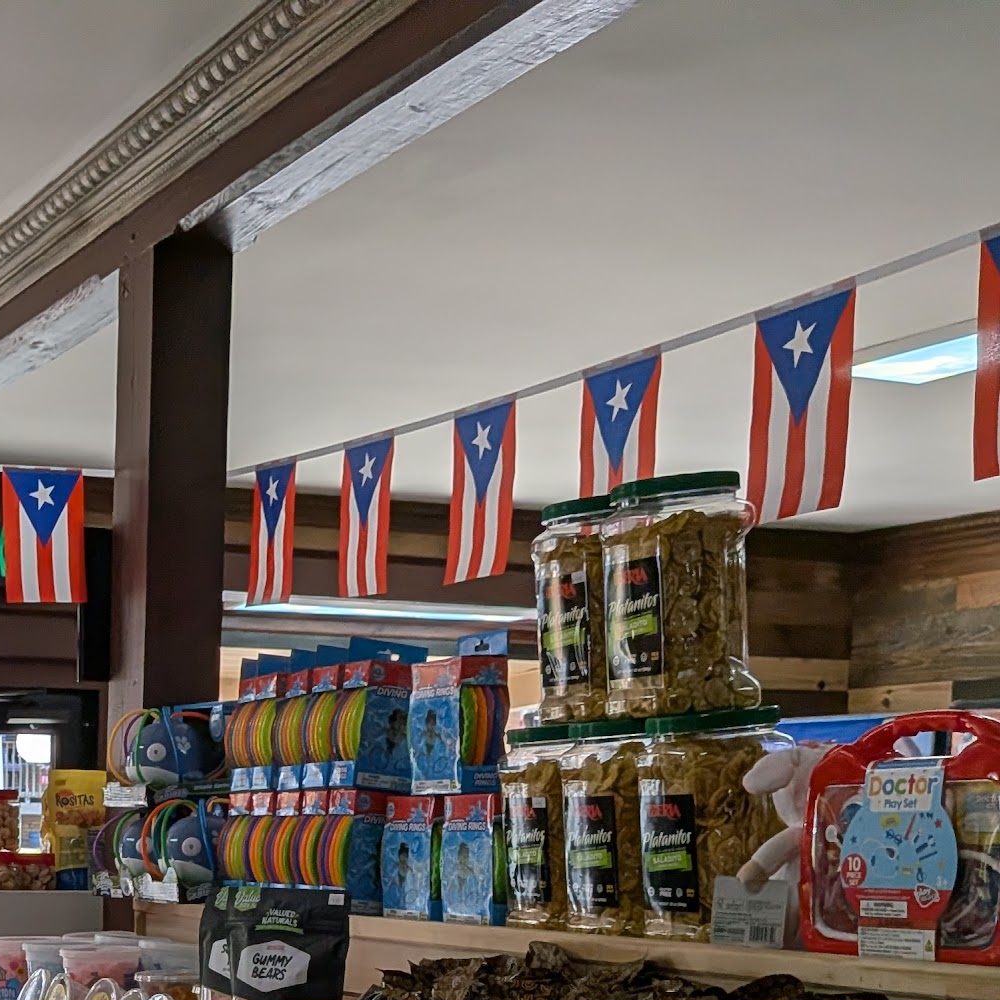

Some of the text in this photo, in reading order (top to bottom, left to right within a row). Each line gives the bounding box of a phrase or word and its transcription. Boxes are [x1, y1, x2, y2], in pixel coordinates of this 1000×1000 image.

[608, 593, 659, 617] Platanitos
[540, 604, 588, 628] Platanitos
[377, 686, 407, 699] DIVING
[435, 685, 457, 698] RINGS
[868, 773, 938, 796] Doctor
[55, 792, 95, 808] ROSITAS
[884, 799, 917, 810] Play Set
[389, 821, 427, 832] DIVING RINGS
[448, 821, 487, 832] DIVING RINGS
[567, 828, 613, 845] Platanitos
[641, 828, 692, 848] Platanitos
[846, 857, 861, 872] 10
[261, 915, 298, 927] NATURALS
[252, 953, 293, 967] GUMMY
[251, 966, 287, 981] BEARS
